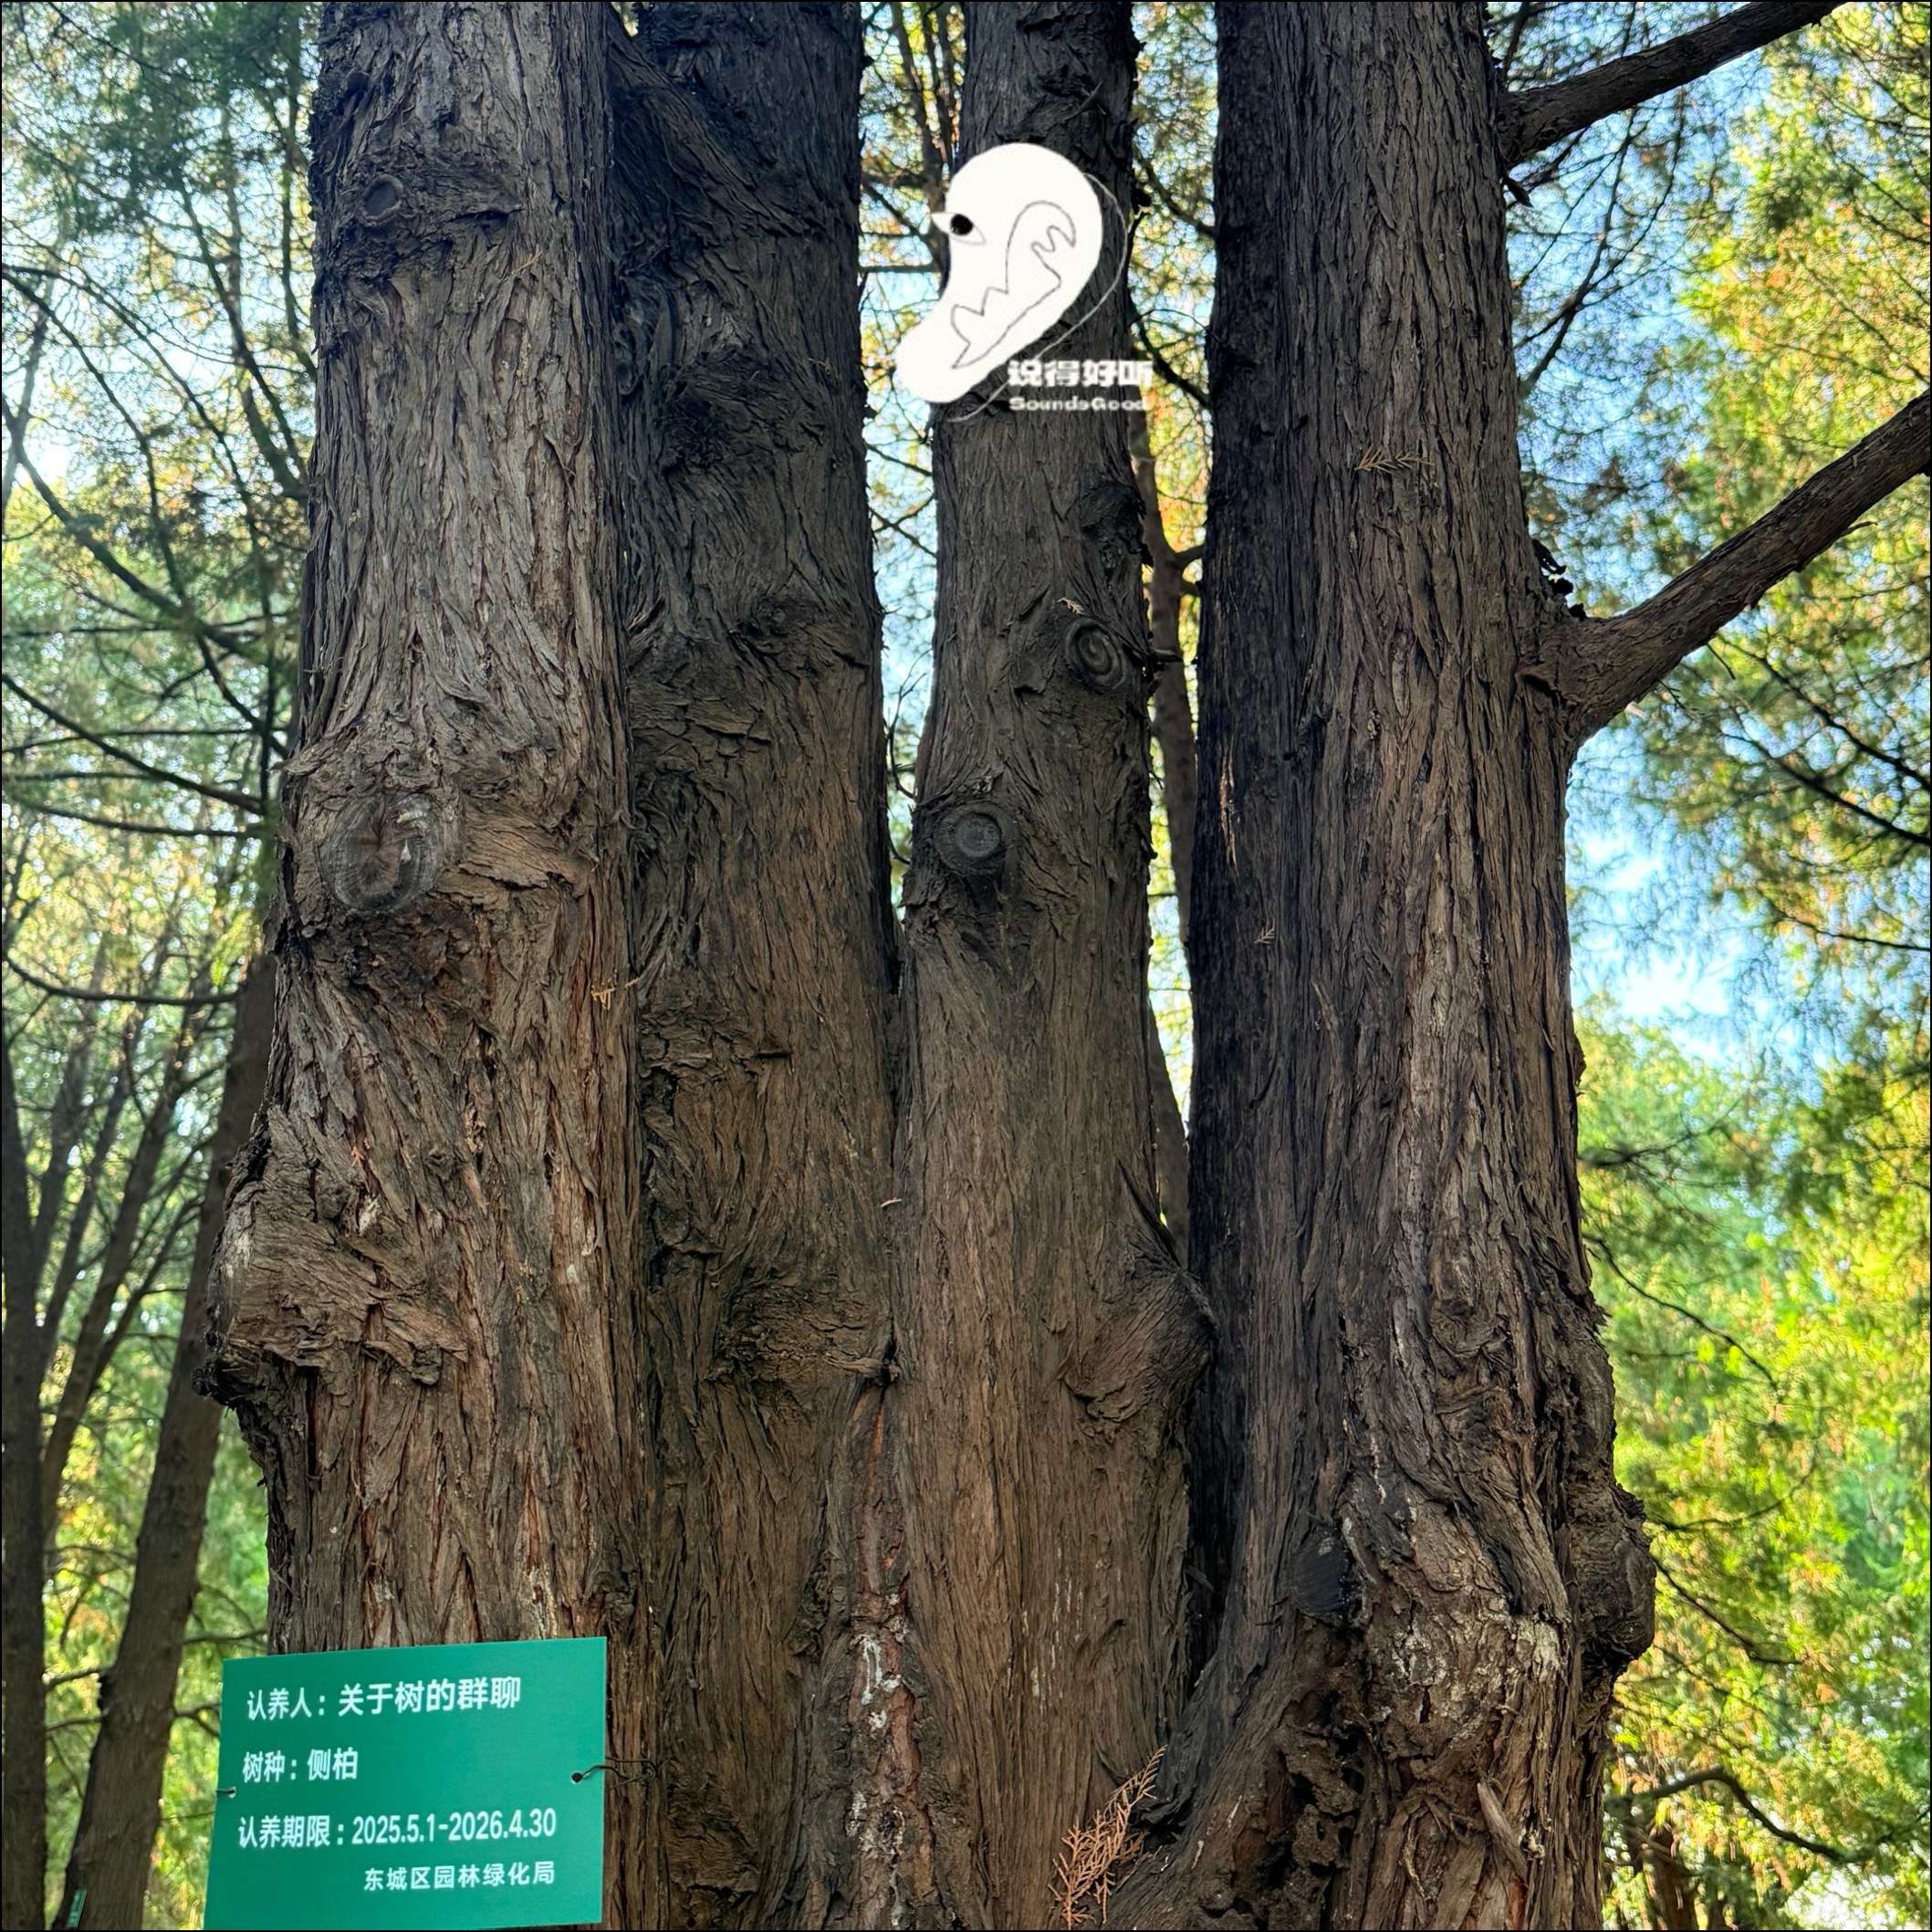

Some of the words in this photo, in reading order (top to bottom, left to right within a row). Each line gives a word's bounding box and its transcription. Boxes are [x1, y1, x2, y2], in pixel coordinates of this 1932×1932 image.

[246, 1676, 522, 1721] 认养人：关于树的群聊
[243, 1747, 359, 1783] 树种：侧柏
[363, 1860, 555, 1891] 东城区园林绿化局
